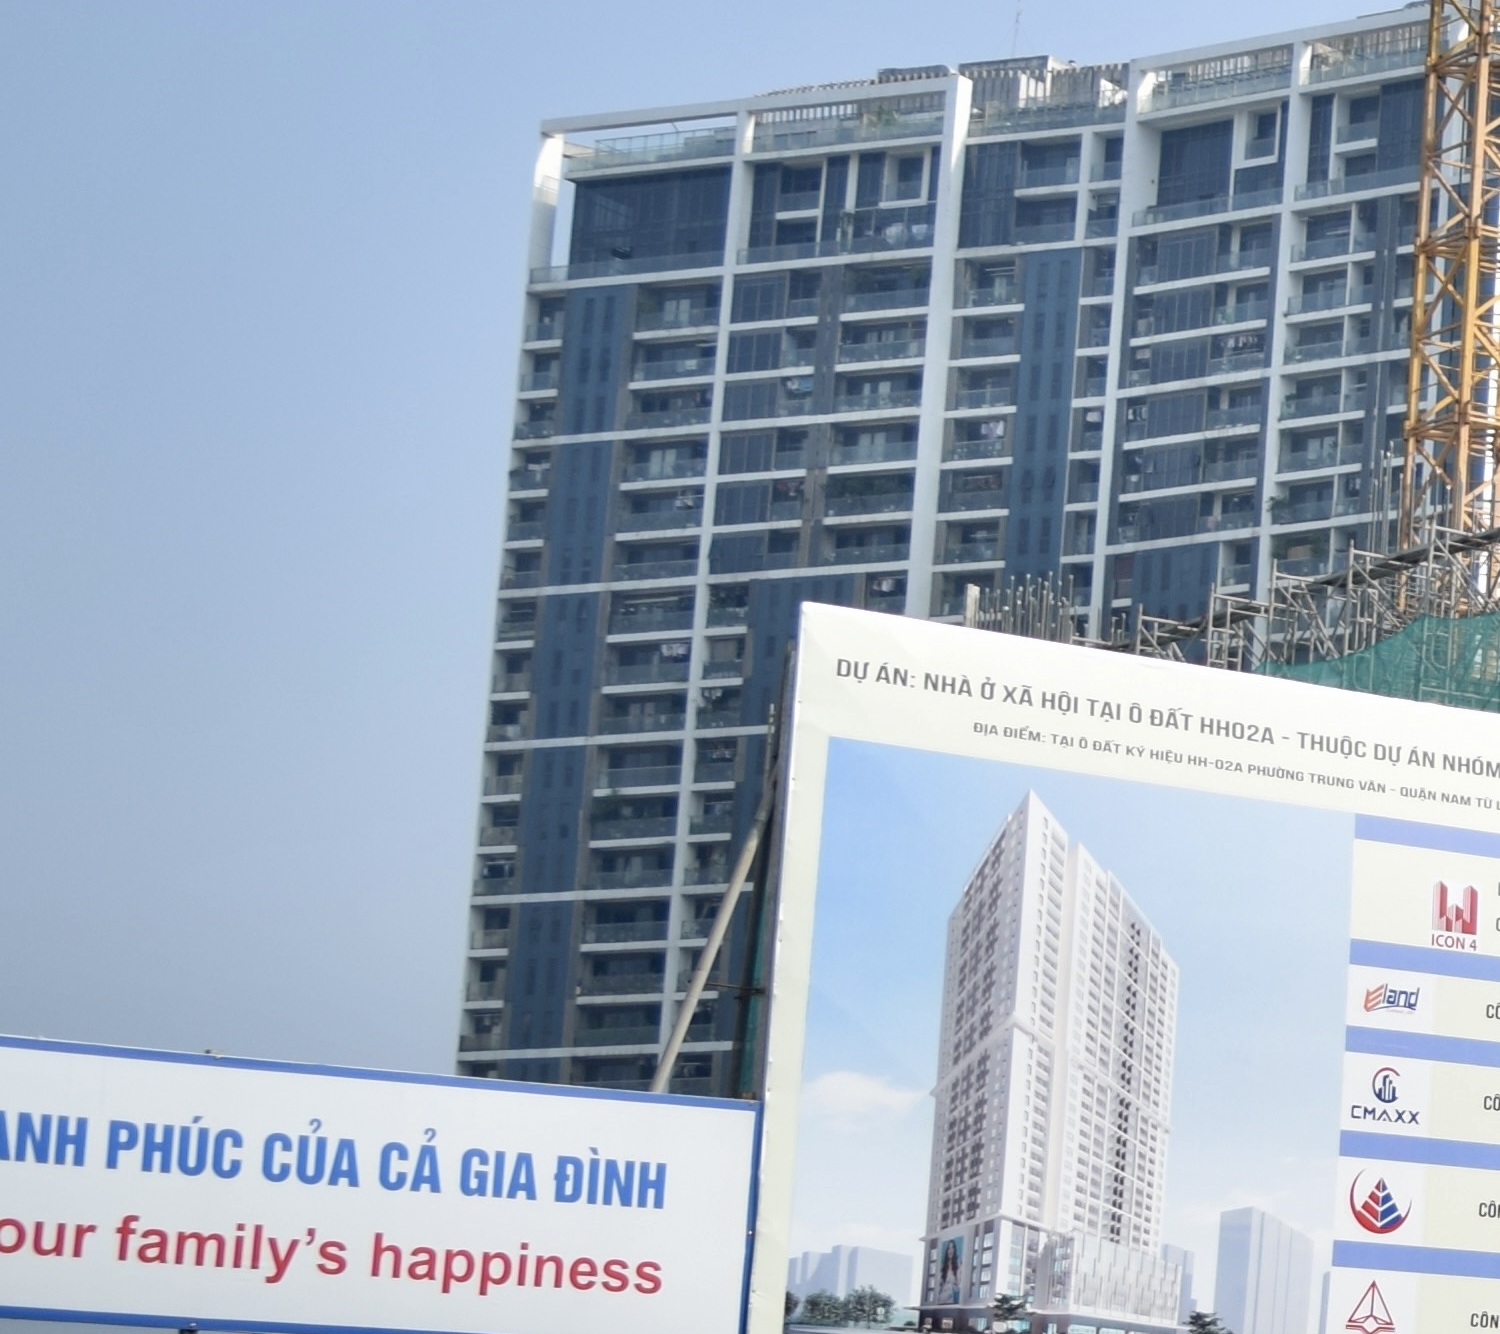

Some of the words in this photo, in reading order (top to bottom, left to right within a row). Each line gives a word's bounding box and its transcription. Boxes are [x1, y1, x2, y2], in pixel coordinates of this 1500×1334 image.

[835, 657, 870, 684] DỰ
[874, 661, 915, 688] ÁN:
[922, 671, 972, 697] NHÀ
[1001, 683, 1033, 707] XÃ
[1040, 689, 1078, 716] HỘI
[1085, 697, 1121, 722] TẠI
[1148, 706, 1193, 731] ĐẤT
[1199, 715, 1274, 744] HH02A
[1295, 730, 1366, 759] THUỘC
[1372, 742, 1402, 766] DỰ
[1406, 745, 1435, 768] ÁN
[972, 721, 998, 736] ĐỊA
[1002, 724, 1046, 743] ĐIỂM:
[1049, 732, 1074, 748] TẠI
[1091, 738, 1121, 754] ĐẤT
[1148, 748, 1183, 764] HIỆU
[1186, 753, 1243, 773] HH-02A
[1246, 762, 1304, 782] PHƯỜNG
[1307, 771, 1354, 789] TRUNG
[1399, 785, 1436, 801] QUẬN
[1440, 791, 1471, 806] NAM
[1431, 933, 1463, 950] ICON
[1467, 936, 1478, 951] 4
[1349, 1103, 1419, 1125] CMAXX
[105, 1117, 243, 1179] PHÚC
[261, 1116, 361, 1190] CỦA
[376, 1125, 443, 1195] CẢ
[458, 1147, 536, 1200] GIA
[553, 1148, 666, 1208] ĐÌNH
[0, 1216, 96, 1258] our
[114, 1213, 347, 1284] family's
[368, 1232, 662, 1296] happiness
